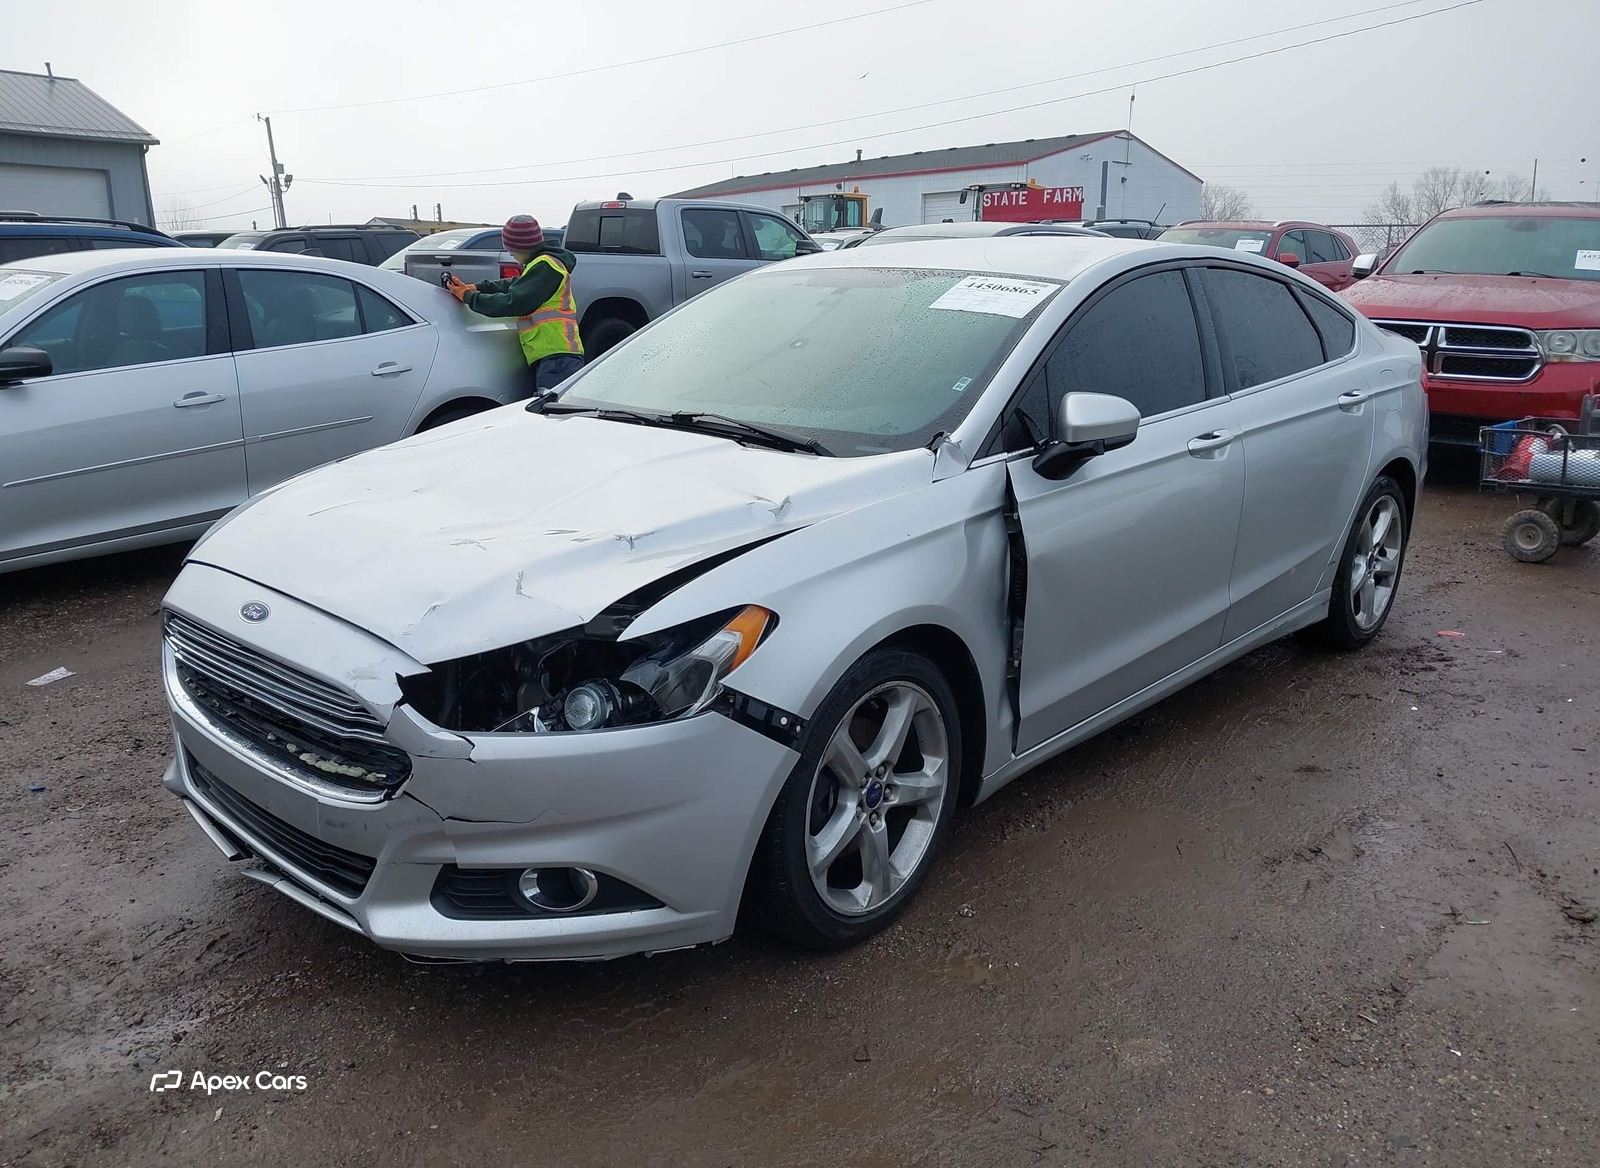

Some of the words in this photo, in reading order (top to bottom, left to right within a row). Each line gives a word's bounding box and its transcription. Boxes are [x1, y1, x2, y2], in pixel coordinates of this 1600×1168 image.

[983, 191, 1028, 207] STATE
[1043, 188, 1083, 204] FARM
[965, 282, 1040, 295] 44506865
[243, 604, 264, 619] Ford
